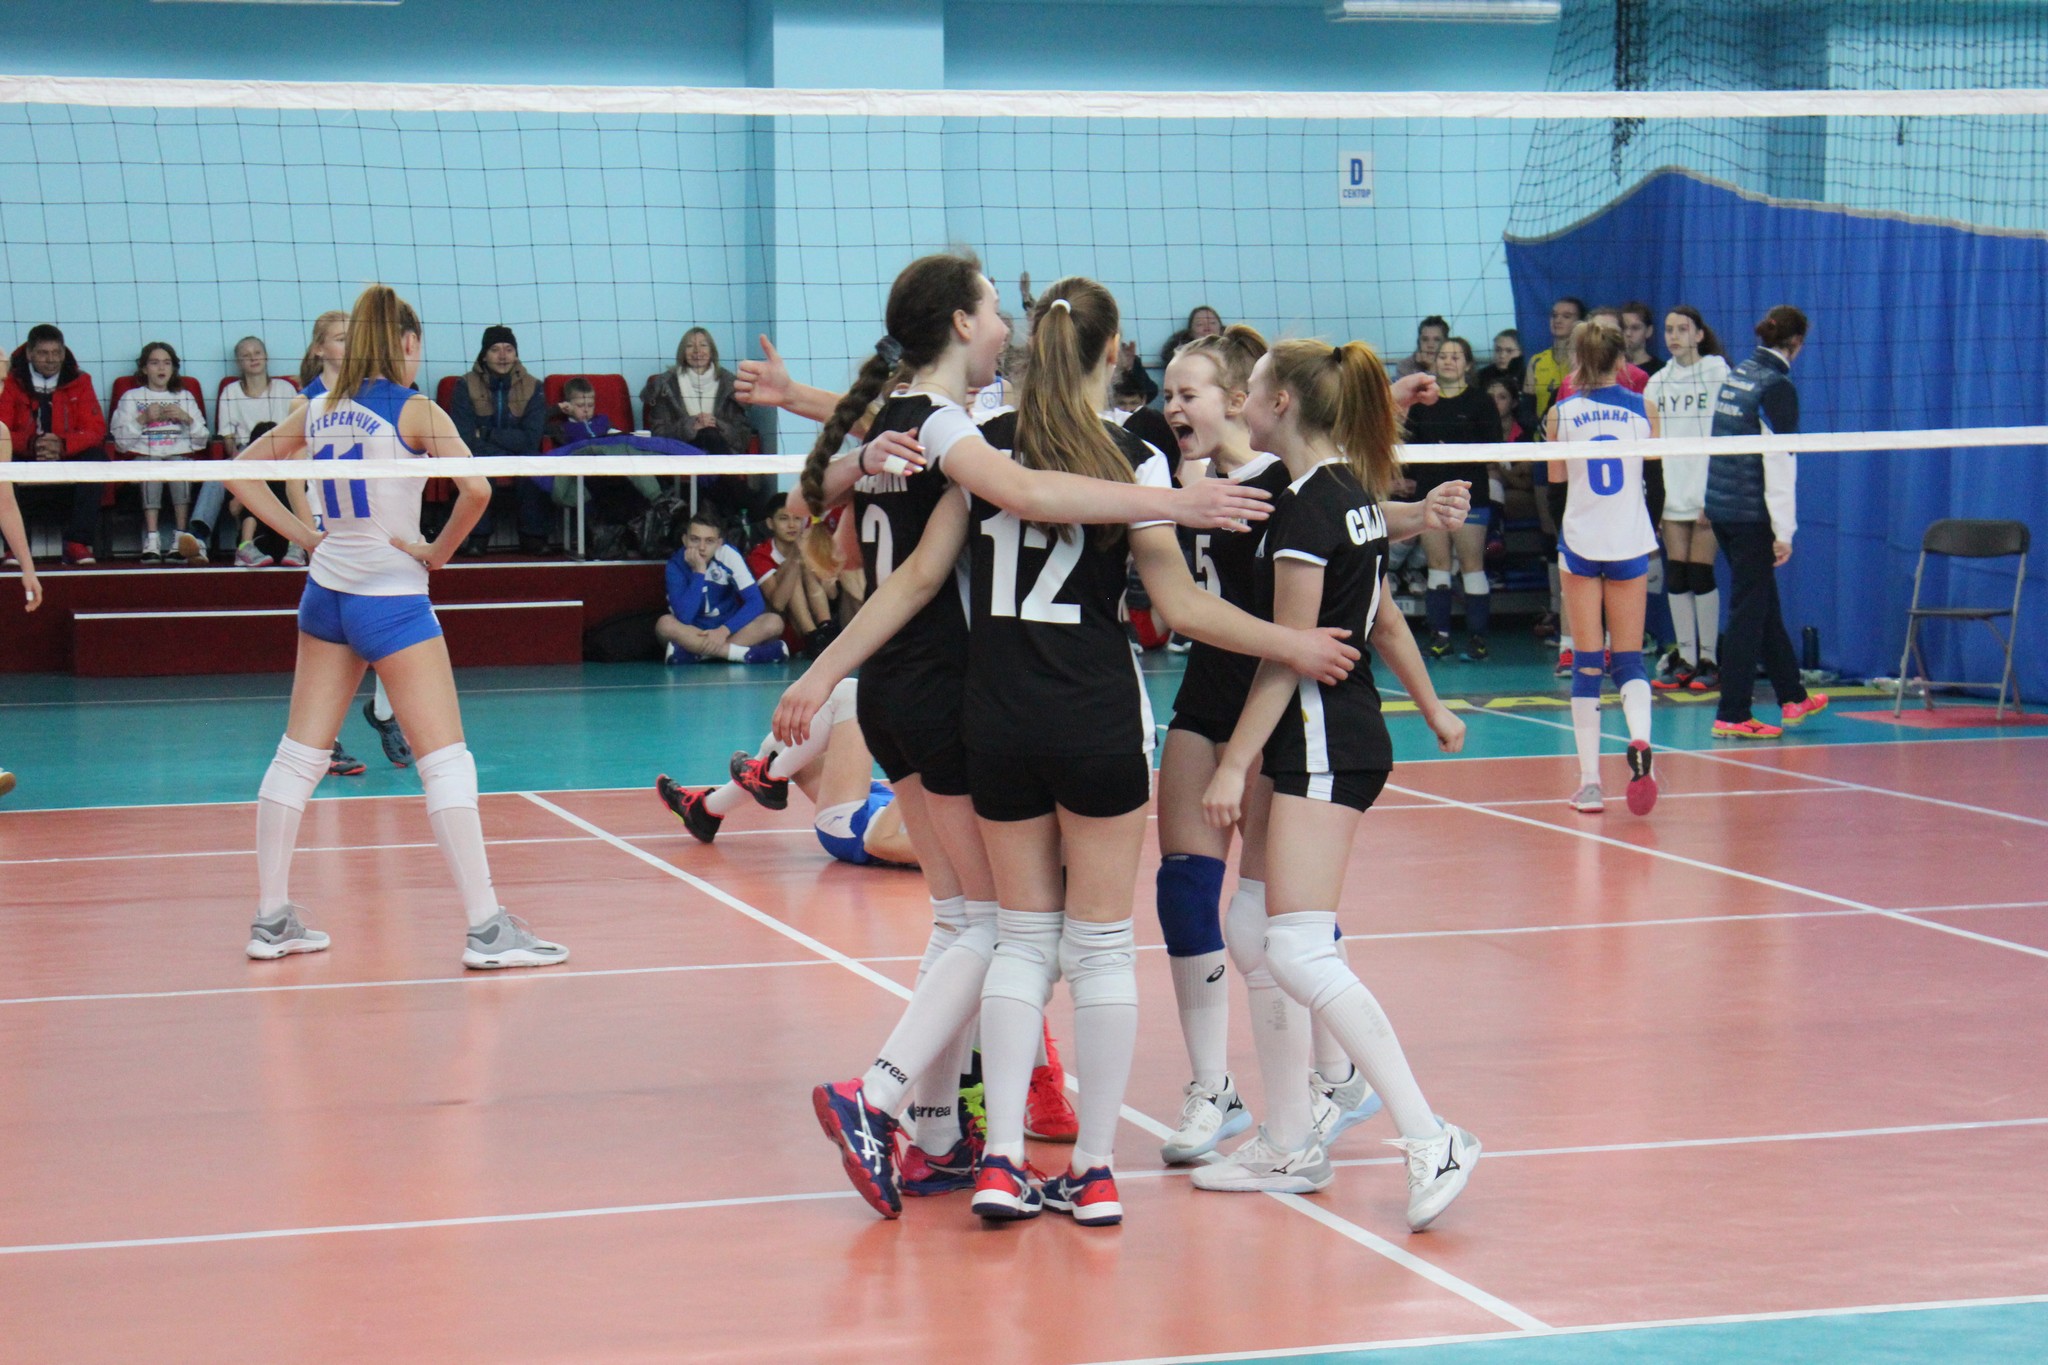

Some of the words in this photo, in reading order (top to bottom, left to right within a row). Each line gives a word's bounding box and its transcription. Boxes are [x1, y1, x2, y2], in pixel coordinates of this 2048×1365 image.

[1350, 158, 1363, 186] D
[1657, 392, 1708, 413] HYPE
[310, 410, 381, 437] СТЕРЕНЧУК
[1573, 409, 1629, 428] КИЛИНА
[312, 442, 371, 519] 11
[980, 508, 1082, 625] 12
[1195, 533, 1222, 598] 5
